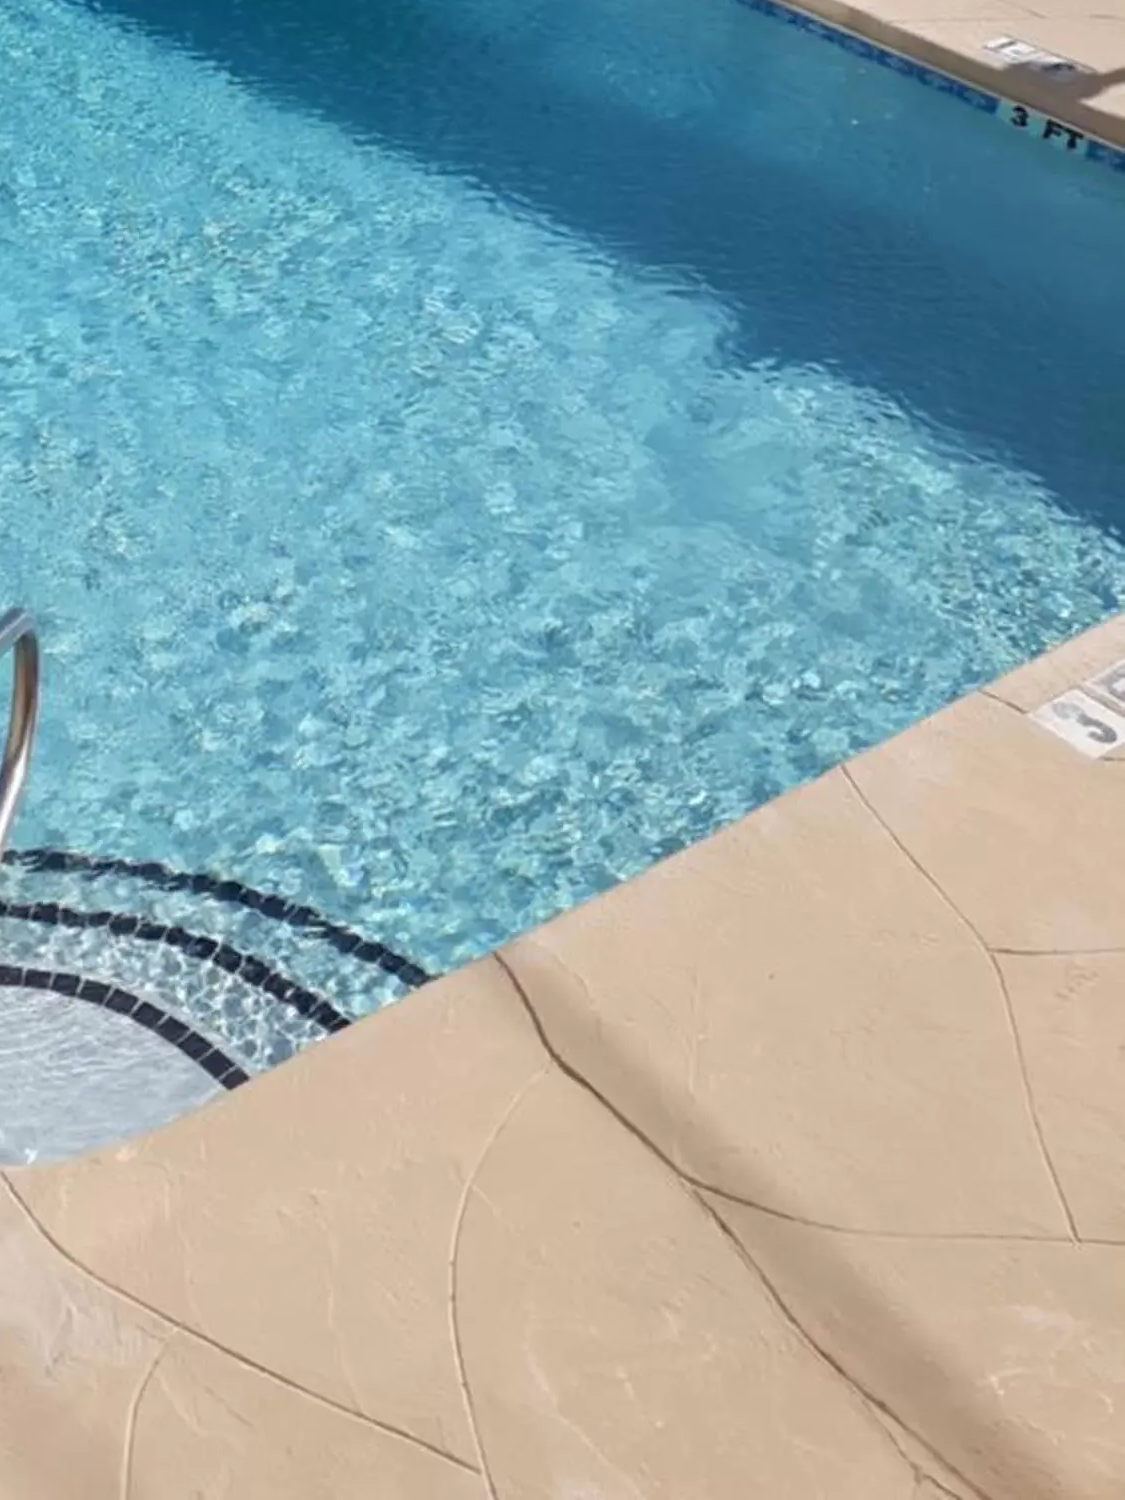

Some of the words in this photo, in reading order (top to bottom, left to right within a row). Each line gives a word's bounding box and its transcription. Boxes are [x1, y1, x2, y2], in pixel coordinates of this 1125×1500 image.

[1011, 106, 1029, 128] 3
[1042, 119, 1085, 149] FT
[1052, 702, 1118, 744] 3
